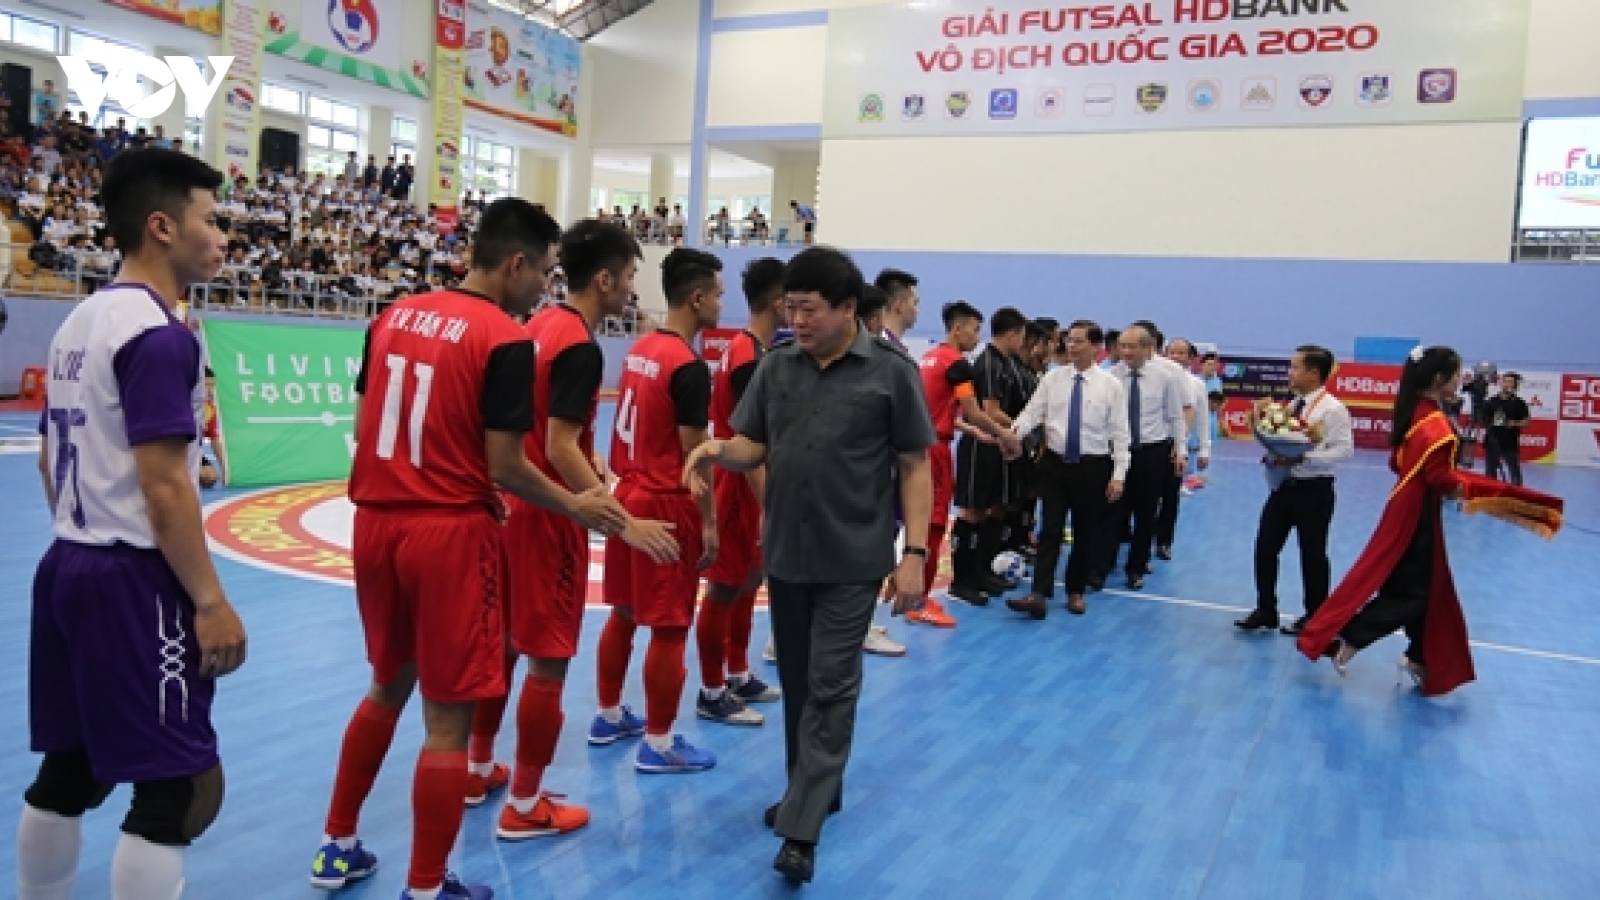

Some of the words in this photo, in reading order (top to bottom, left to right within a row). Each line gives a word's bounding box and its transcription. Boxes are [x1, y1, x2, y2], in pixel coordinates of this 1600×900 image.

[1019, 3, 1163, 34] FUTSAL
[1173, 0, 1349, 23] HDBANK
[915, 43, 963, 73] VÔ
[971, 44, 1052, 75] ĐỊCH
[1062, 29, 1169, 66] QUỐC
[1179, 32, 1248, 60] GIA
[1256, 24, 1379, 56] 2020
[375, 353, 435, 470] 11
